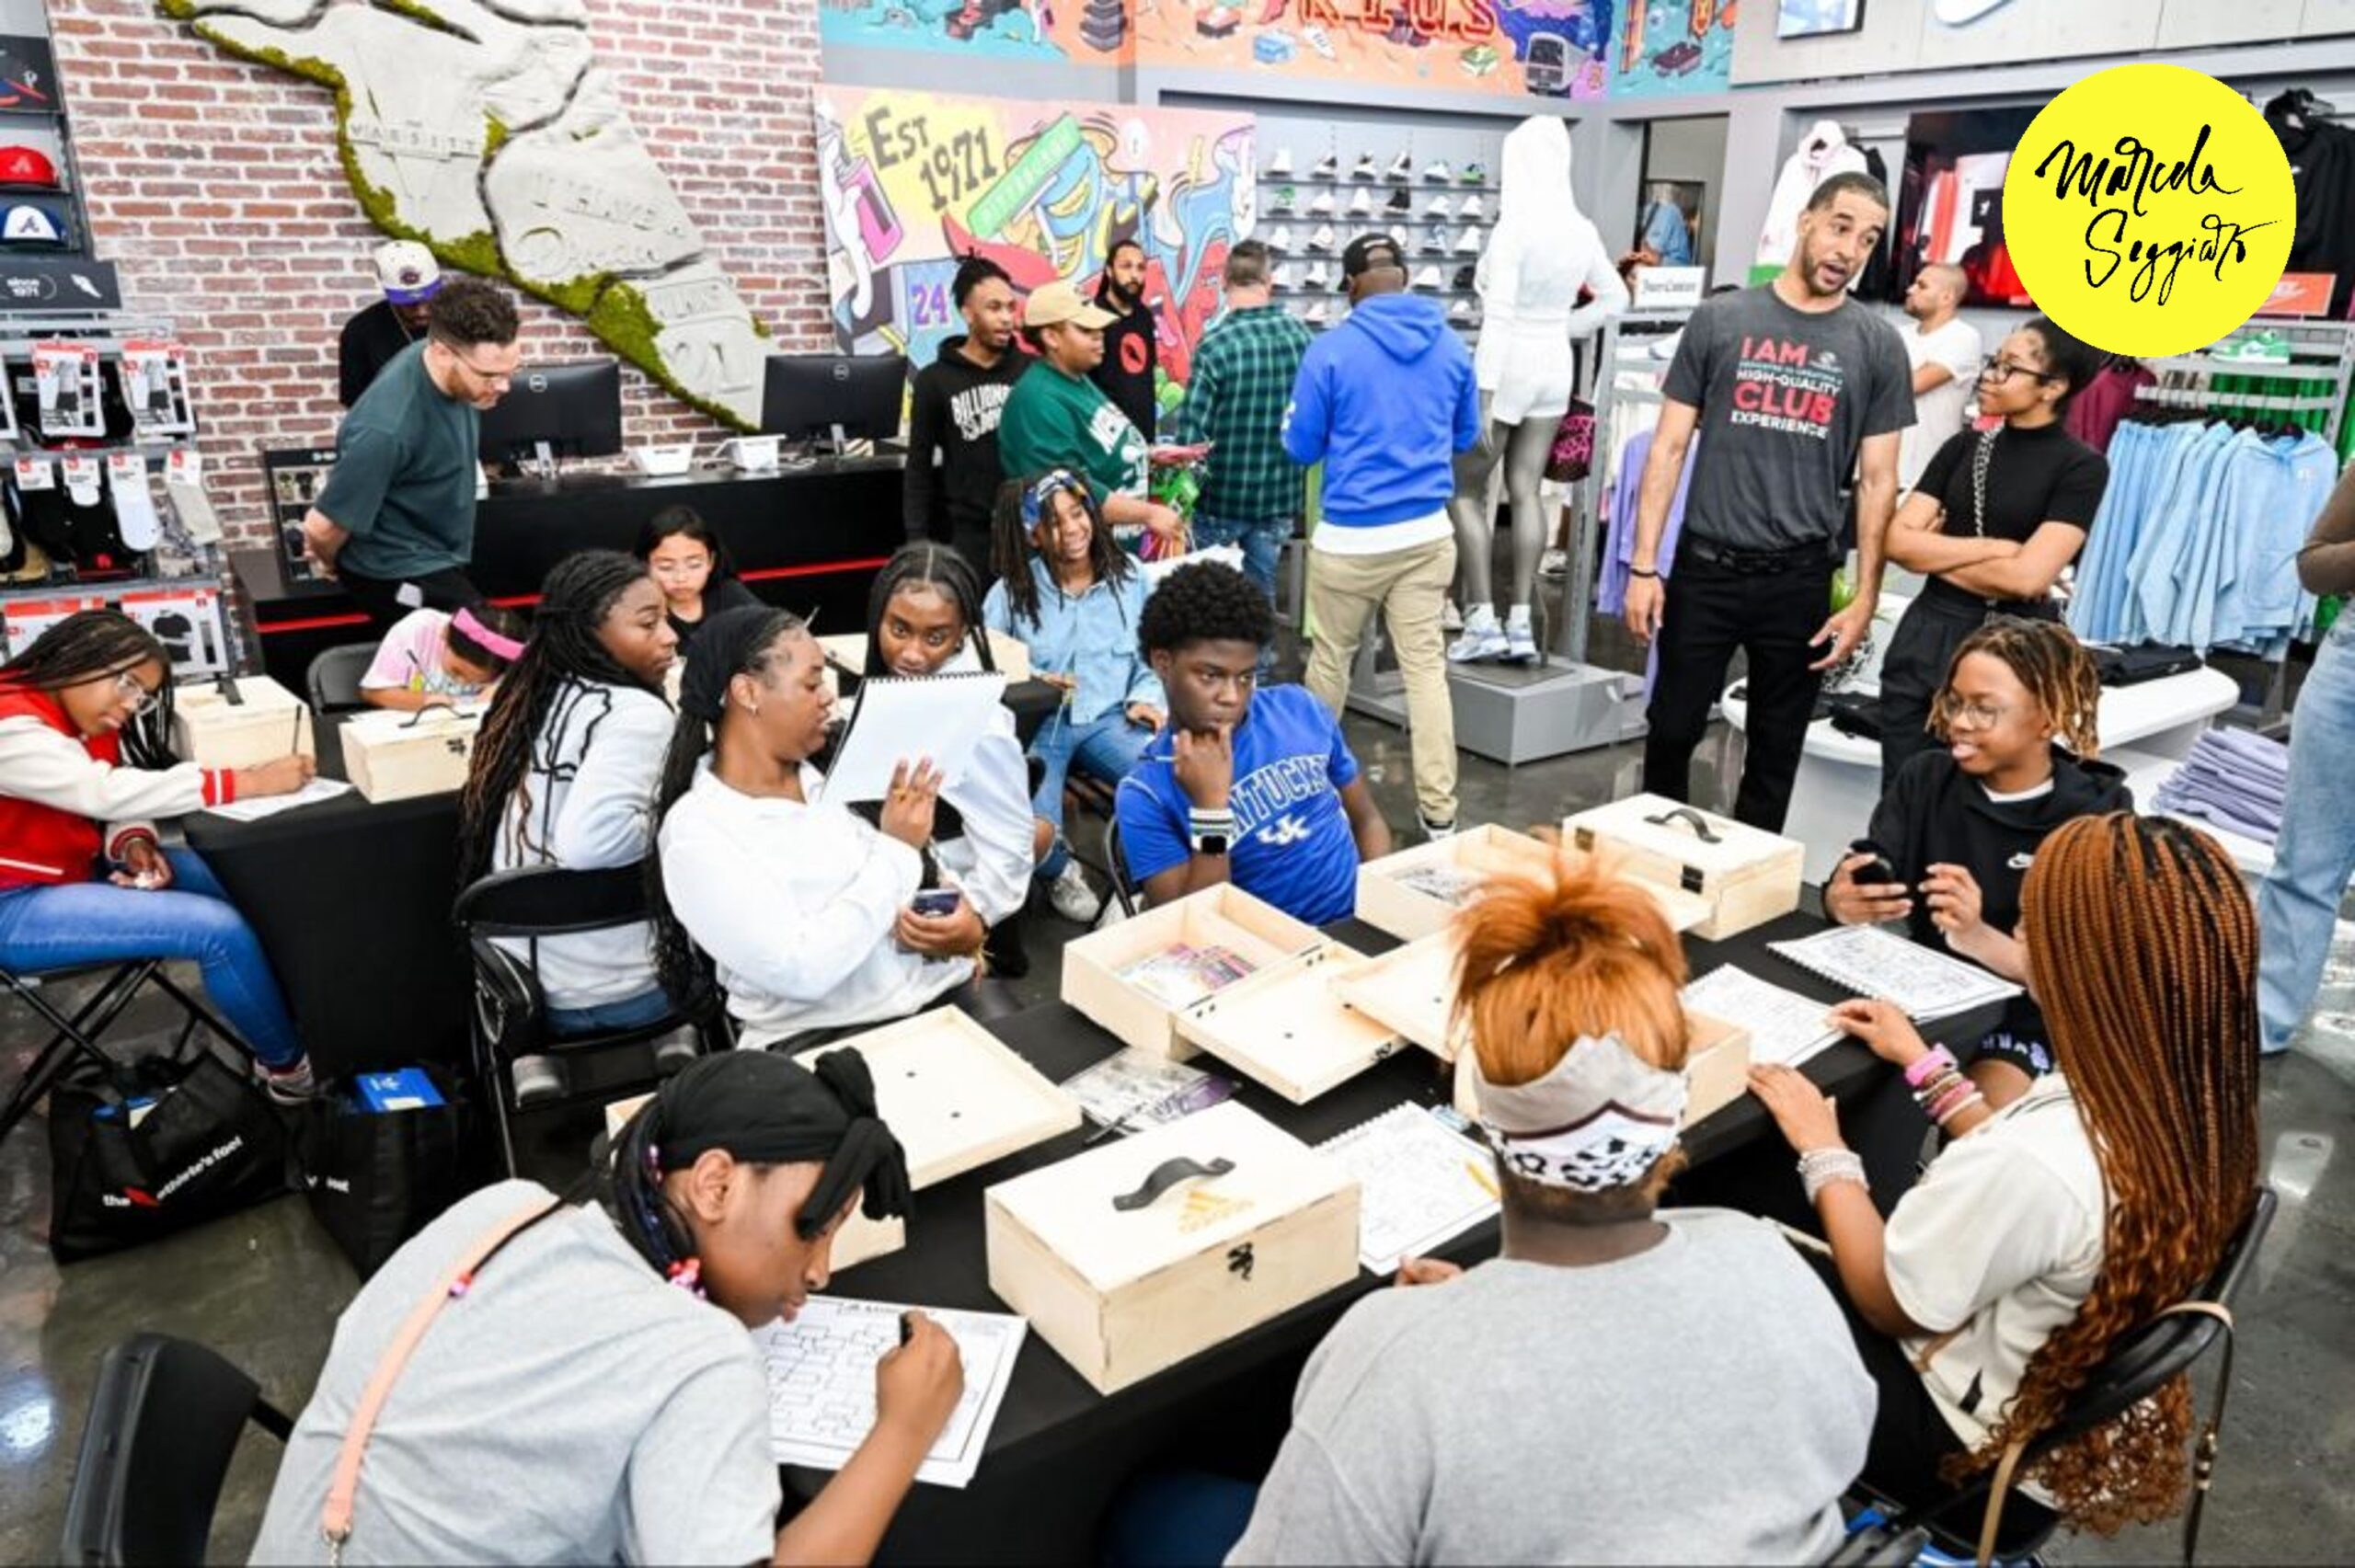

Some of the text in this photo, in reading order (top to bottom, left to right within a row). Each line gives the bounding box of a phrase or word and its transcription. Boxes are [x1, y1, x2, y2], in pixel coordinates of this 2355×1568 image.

[920, 126, 996, 211] 1971
[911, 283, 949, 327] 24
[1741, 337, 1753, 360] I
[1753, 338, 1809, 367] AM
[1737, 369, 1841, 396] HIGH-QUALITY
[1734, 381, 1835, 424] CLUB
[1730, 410, 1830, 440] EXPERIENCE
[102, 1194, 131, 1207] the
